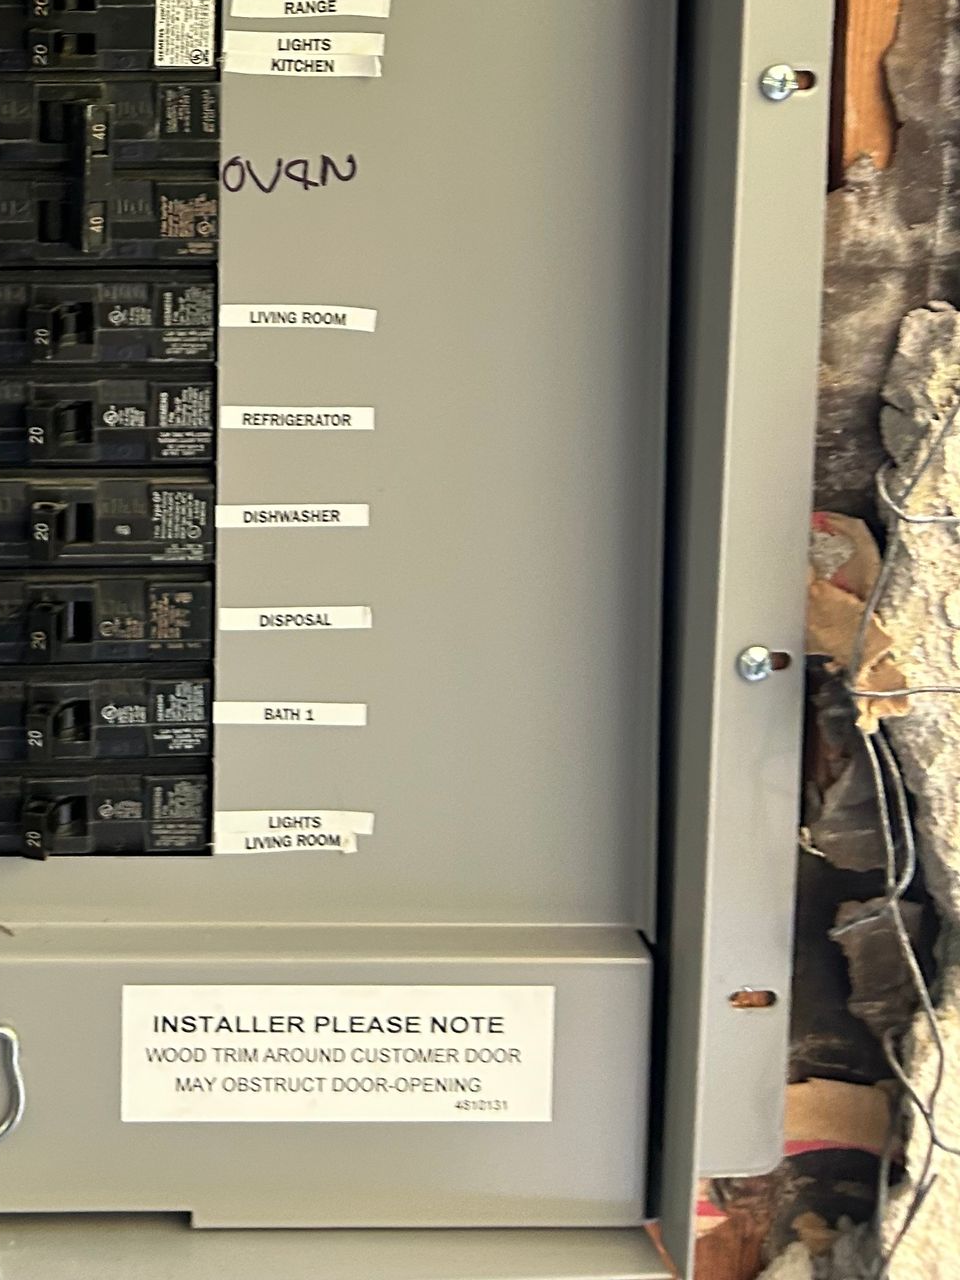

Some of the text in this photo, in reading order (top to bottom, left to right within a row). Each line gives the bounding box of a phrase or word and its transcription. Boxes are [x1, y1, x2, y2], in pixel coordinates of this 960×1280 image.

[284, 0, 336, 14] RANGE
[278, 38, 331, 52] LIGHTS
[32, 44, 48, 66] 20
[271, 59, 334, 73] KITCHEN
[92, 124, 106, 140] 40
[89, 216, 104, 234] 40
[249, 311, 347, 325] LIVING ROOM
[35, 328, 50, 346] 20
[243, 413, 351, 426] REFRIGERATOR
[29, 426, 45, 445] 20
[244, 510, 340, 523] DISHWASHER
[33, 522, 50, 541] 20
[260, 614, 331, 627] DISPOSAL
[31, 631, 48, 650] 20
[264, 709, 314, 721] BATH 1
[28, 729, 44, 747] 20
[269, 816, 321, 829] LIGHTS
[27, 830, 43, 848] 20
[245, 833, 340, 850] LIVING ROOM
[153, 1016, 505, 1034] INSTALLER PLEASE NOTE
[147, 1048, 521, 1063] WOOD TRIM AROUND CUSTOMER DOOR
[175, 1077, 482, 1093] MAY OBSTRUCT DOOR-OPENING
